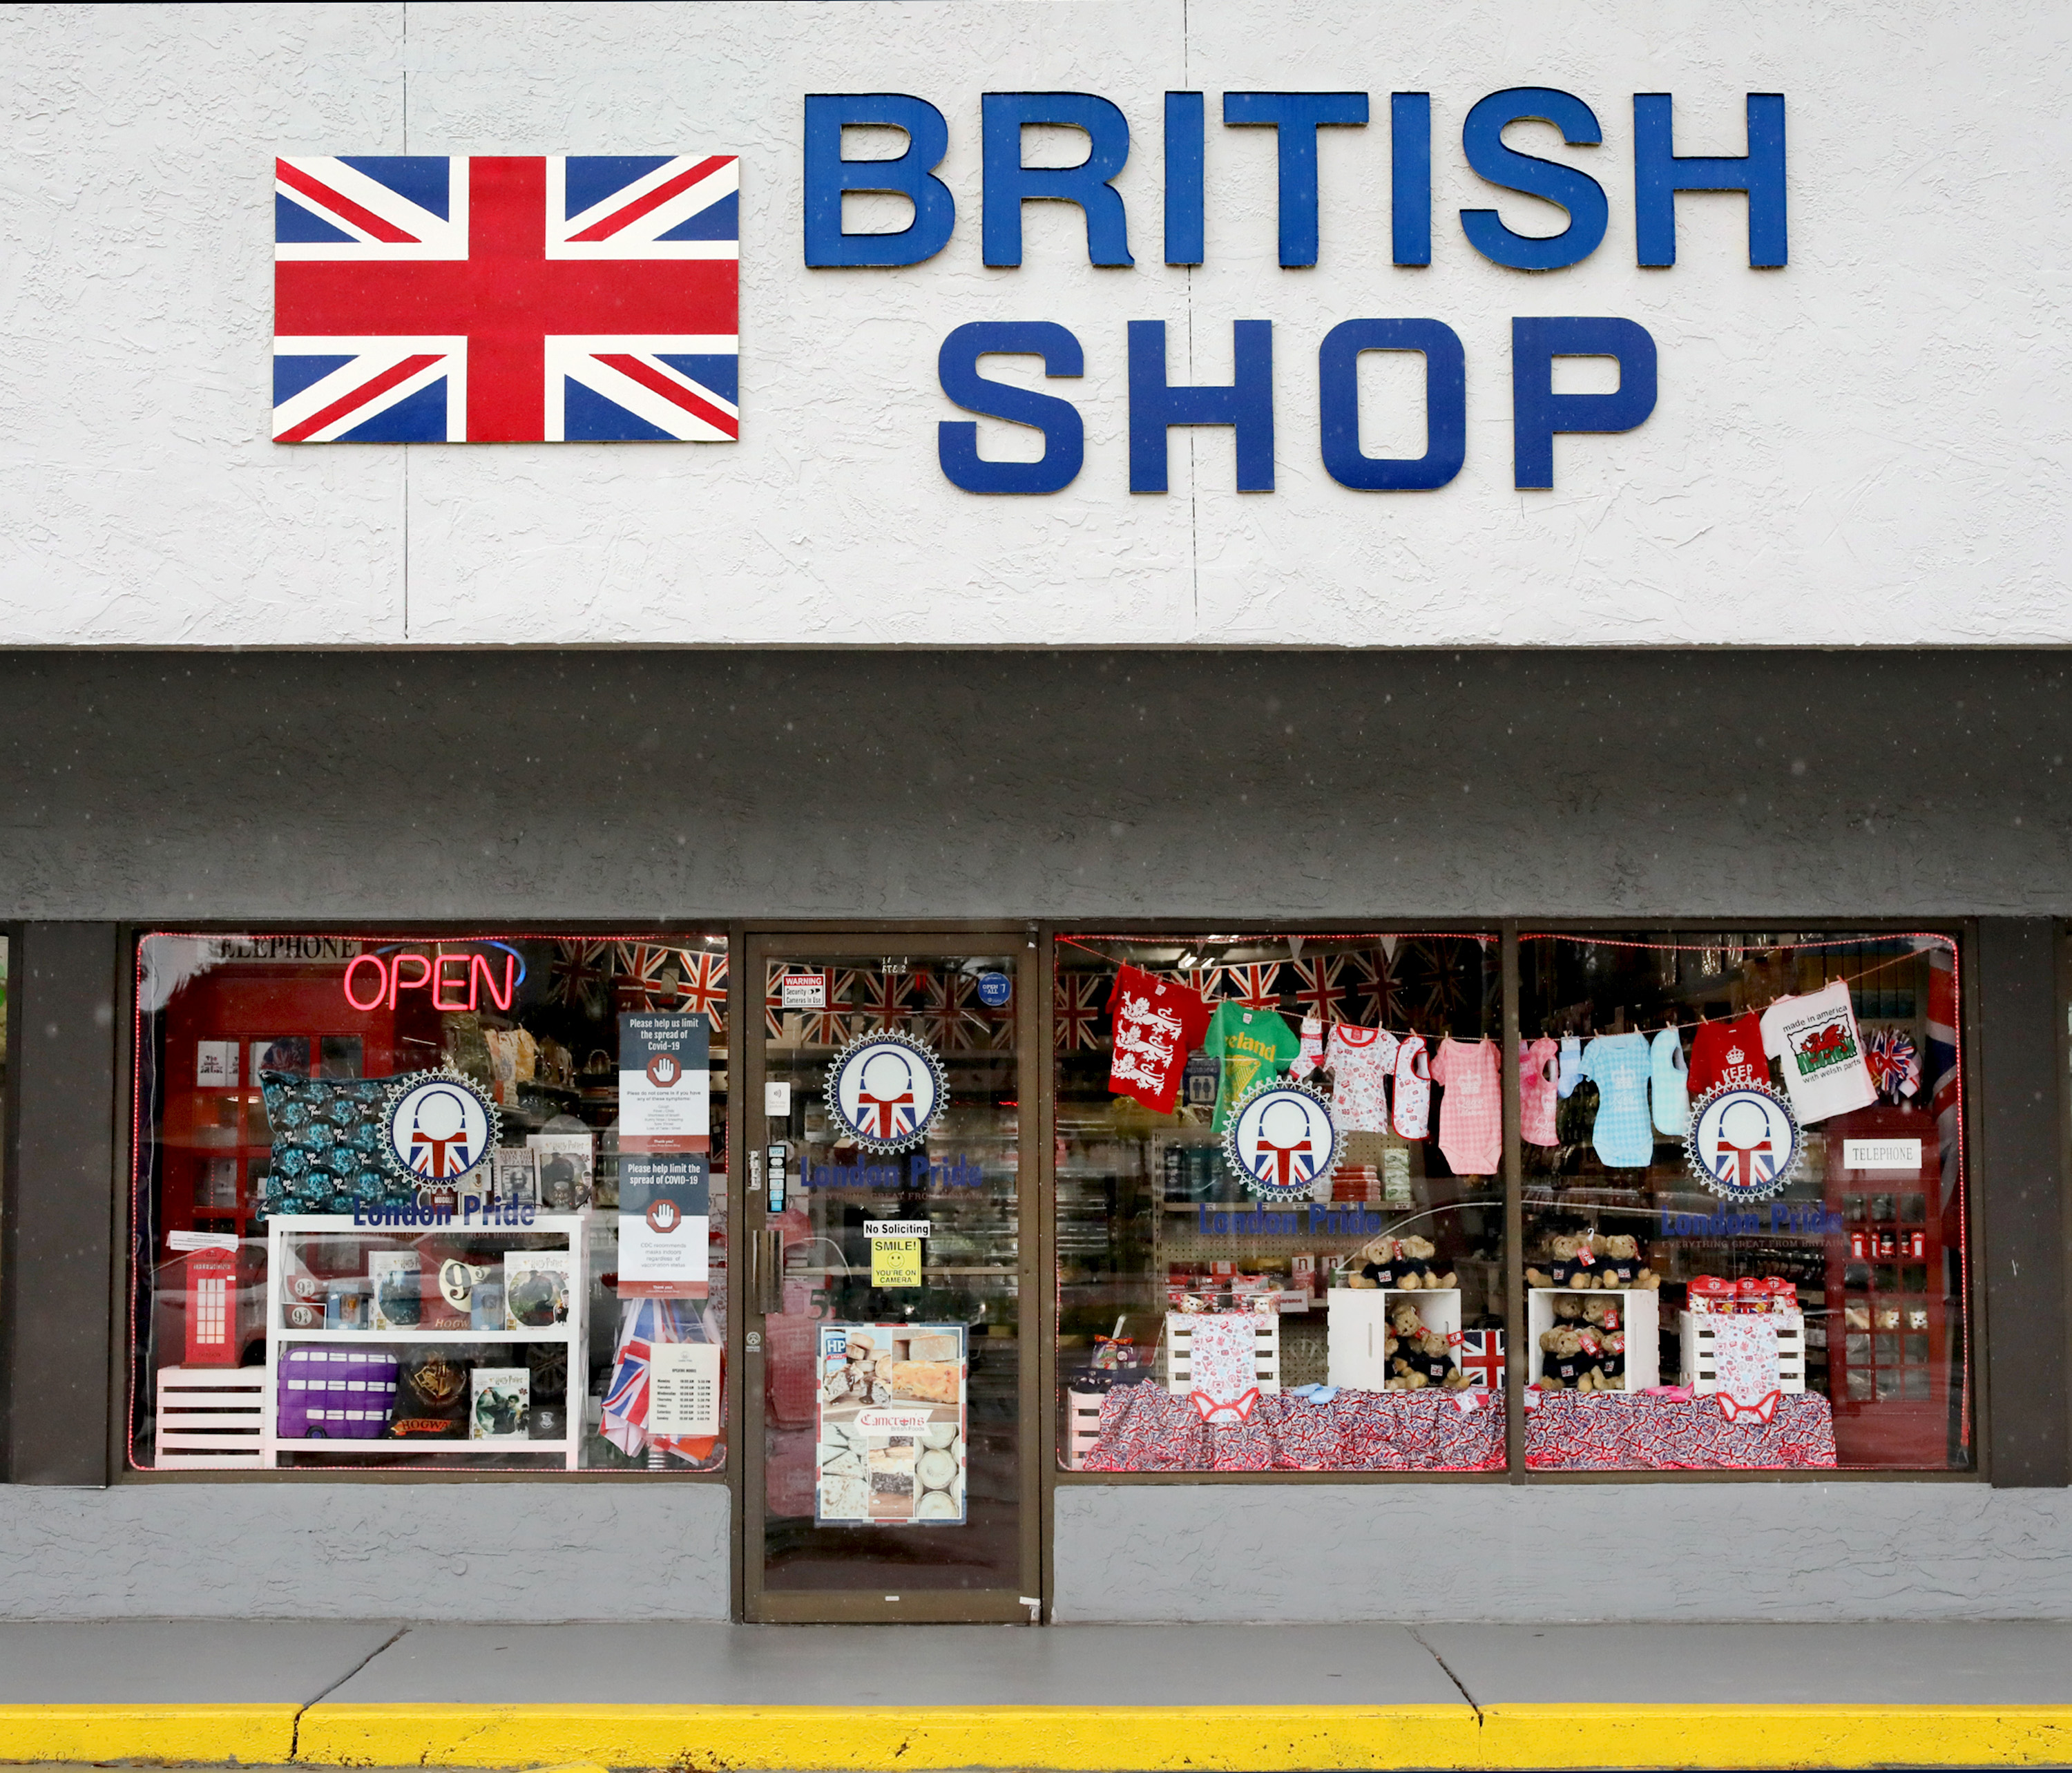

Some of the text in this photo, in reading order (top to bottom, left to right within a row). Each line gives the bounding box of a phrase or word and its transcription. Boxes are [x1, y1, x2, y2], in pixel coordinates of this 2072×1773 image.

[803, 86, 1789, 270] BRITISH
[938, 316, 1658, 494] SHOP
[220, 937, 356, 958] ELEPHONE
[343, 954, 514, 1011] OPEN
[785, 977, 822, 986] WARNING
[786, 988, 806, 996] Security
[630, 1018, 653, 1028] Please
[654, 1019, 670, 1029] help
[682, 1018, 699, 1028] limit
[1783, 1005, 1848, 1033] made in america
[641, 1030, 688, 1041] the spread of
[648, 1041, 680, 1051] Covid-19
[1225, 1031, 1277, 1063] eland
[1721, 1064, 1753, 1082] KEEP
[1802, 1059, 1861, 1084] with welsh parts
[1852, 1147, 1913, 1161] TELEPHONE
[628, 1163, 700, 1174] Please help limit the
[800, 1153, 983, 1187] London Pride
[630, 1175, 698, 1186] spread of COVID-19
[353, 1191, 535, 1226] London Pride
[1199, 1201, 1381, 1234] London Pride
[1661, 1202, 1843, 1236] London Pride
[865, 1224, 929, 1236] No Soliciting
[874, 1241, 917, 1251] SMILE!
[1662, 1240, 1727, 1249] EVERYTHING
[1732, 1240, 1764, 1249] GREAT
[1769, 1240, 1798, 1249] FROM
[1298, 1258, 1308, 1269] n
[1329, 1257, 1338, 1268] n
[445, 1263, 472, 1301] 9
[827, 1340, 846, 1353] HP
